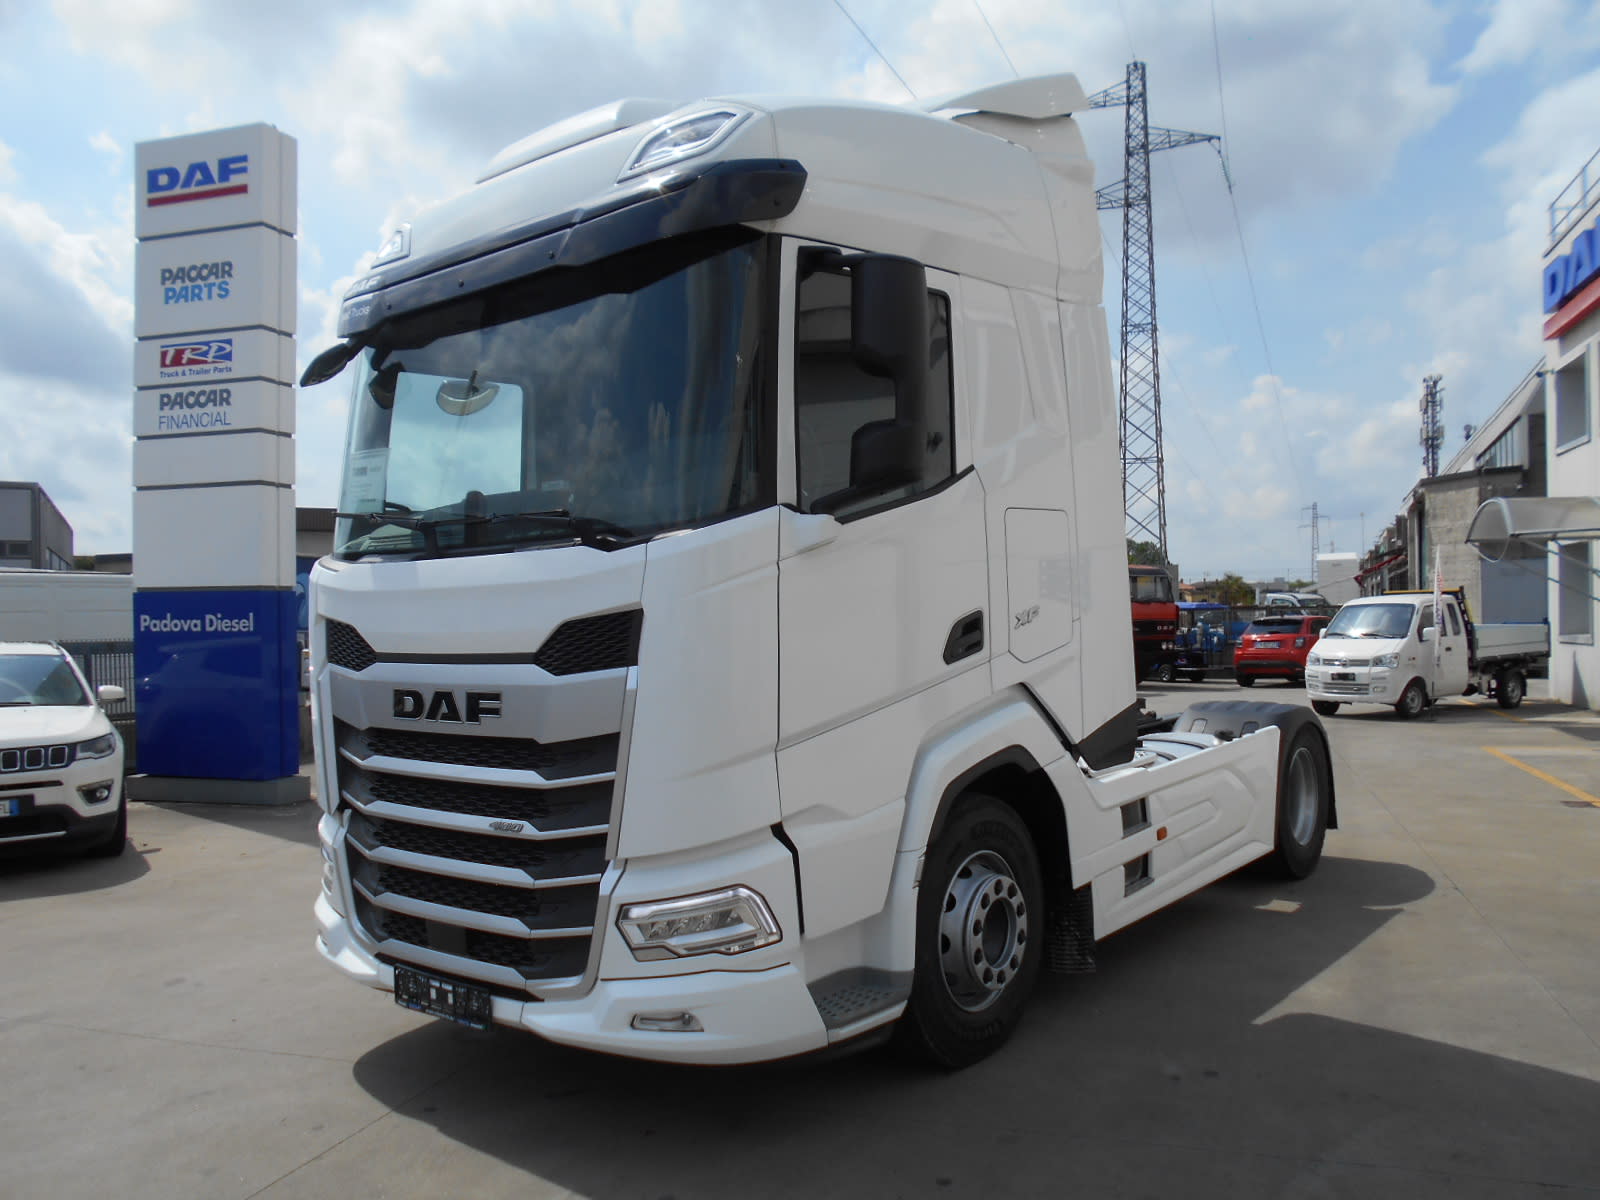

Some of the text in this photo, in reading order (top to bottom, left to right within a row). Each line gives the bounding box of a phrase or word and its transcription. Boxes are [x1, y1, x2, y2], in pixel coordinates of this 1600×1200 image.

[147, 154, 248, 194] DAF
[160, 261, 233, 286] PACCAR
[164, 280, 230, 305] PARTS
[160, 341, 232, 367] TRP
[160, 366, 232, 378] Truck & Trailer Parts
[159, 388, 232, 411] PACCAR
[158, 411, 232, 431] FINANCIAL
[140, 612, 254, 632] Padova Diesel
[393, 688, 502, 725] DAF
